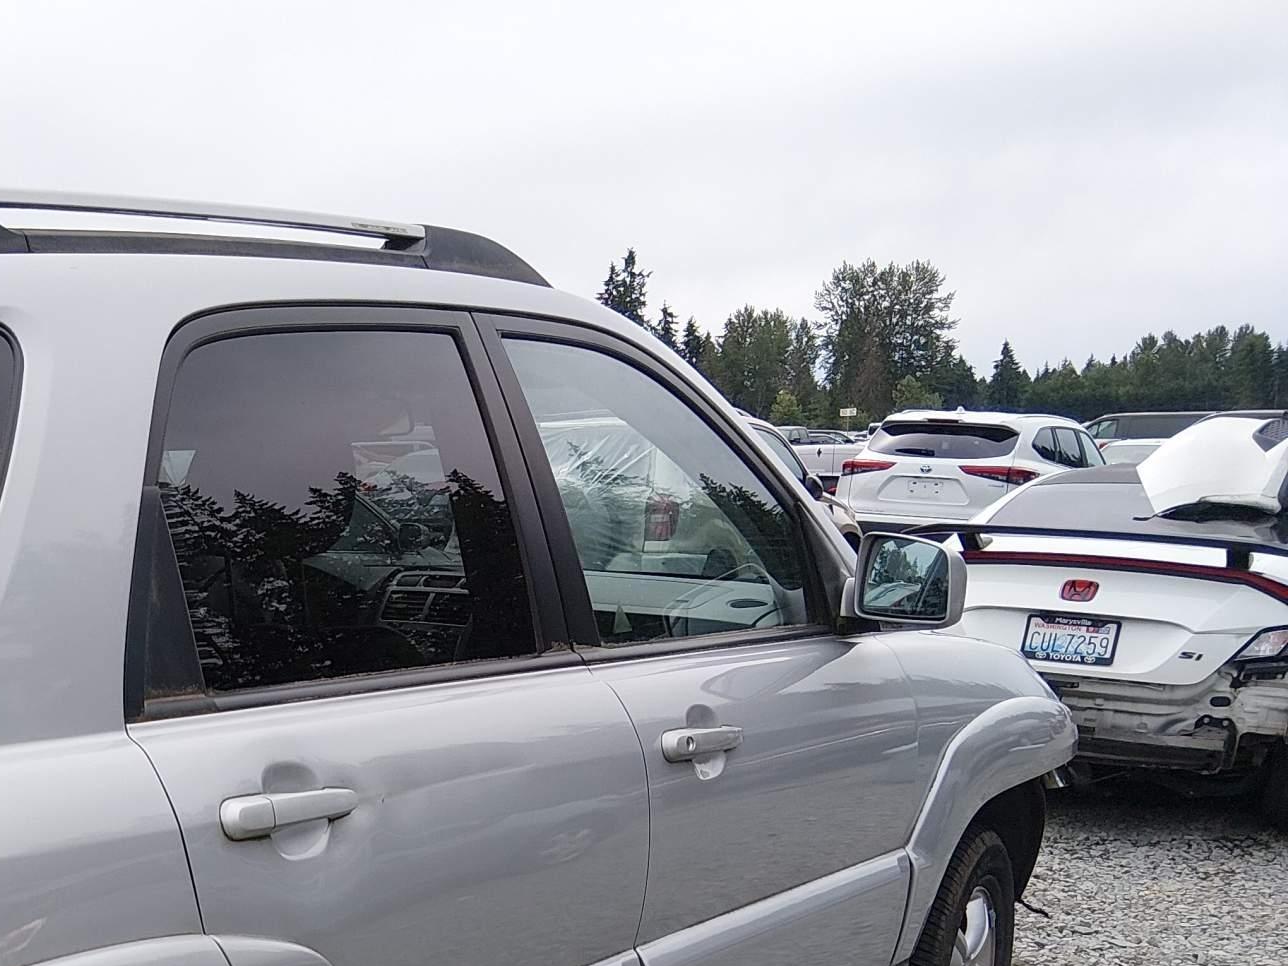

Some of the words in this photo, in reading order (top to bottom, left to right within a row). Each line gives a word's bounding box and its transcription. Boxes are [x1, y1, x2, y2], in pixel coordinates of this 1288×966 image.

[1034, 622, 1081, 632] WASHINGTON
[1029, 631, 1110, 657] CUL7259
[1049, 651, 1081, 662] TOYOTA
